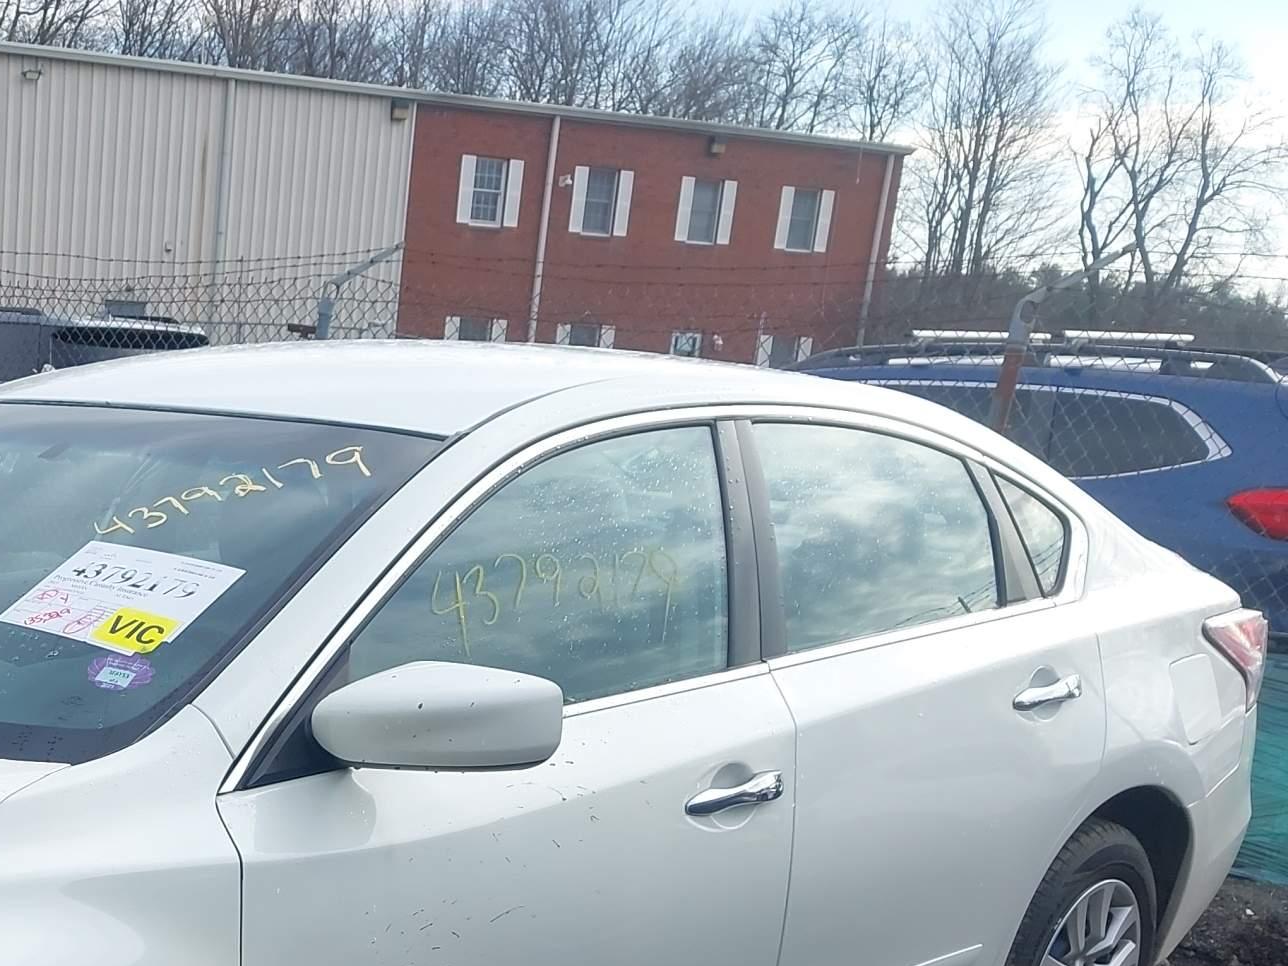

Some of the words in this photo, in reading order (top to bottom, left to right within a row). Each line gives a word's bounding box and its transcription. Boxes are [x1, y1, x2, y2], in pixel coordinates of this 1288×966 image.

[93, 446, 372, 535] 43792179
[72, 560, 200, 599] 43792179
[430, 551, 678, 658] 43792179
[108, 614, 165, 645] VIC
